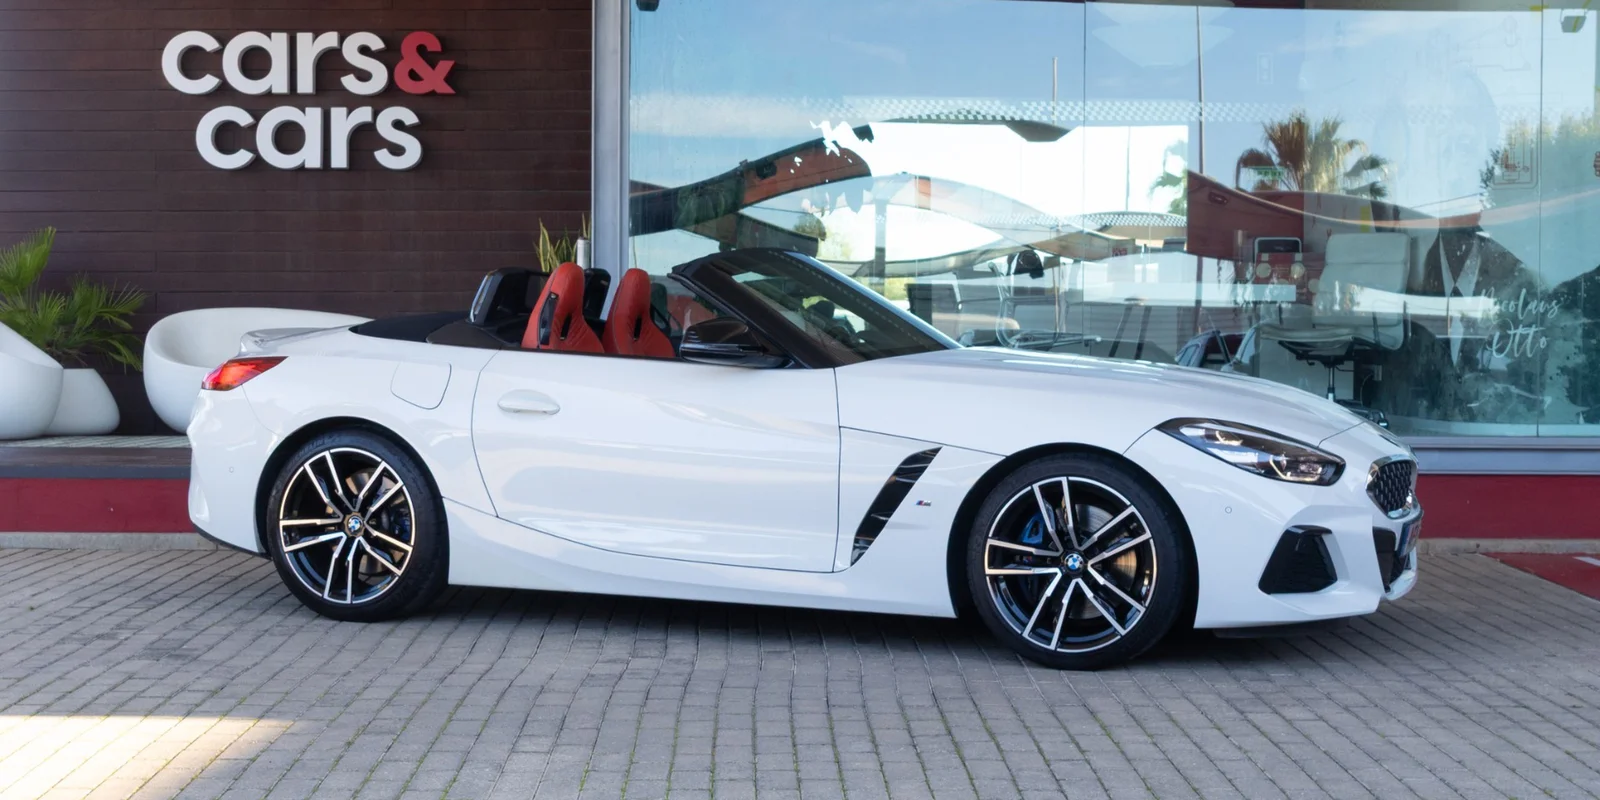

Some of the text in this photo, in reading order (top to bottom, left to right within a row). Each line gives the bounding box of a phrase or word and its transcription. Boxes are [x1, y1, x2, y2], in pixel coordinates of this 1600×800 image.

[161, 30, 456, 96] cars&
[195, 105, 424, 170] cars
[1486, 318, 1550, 358] Otto
